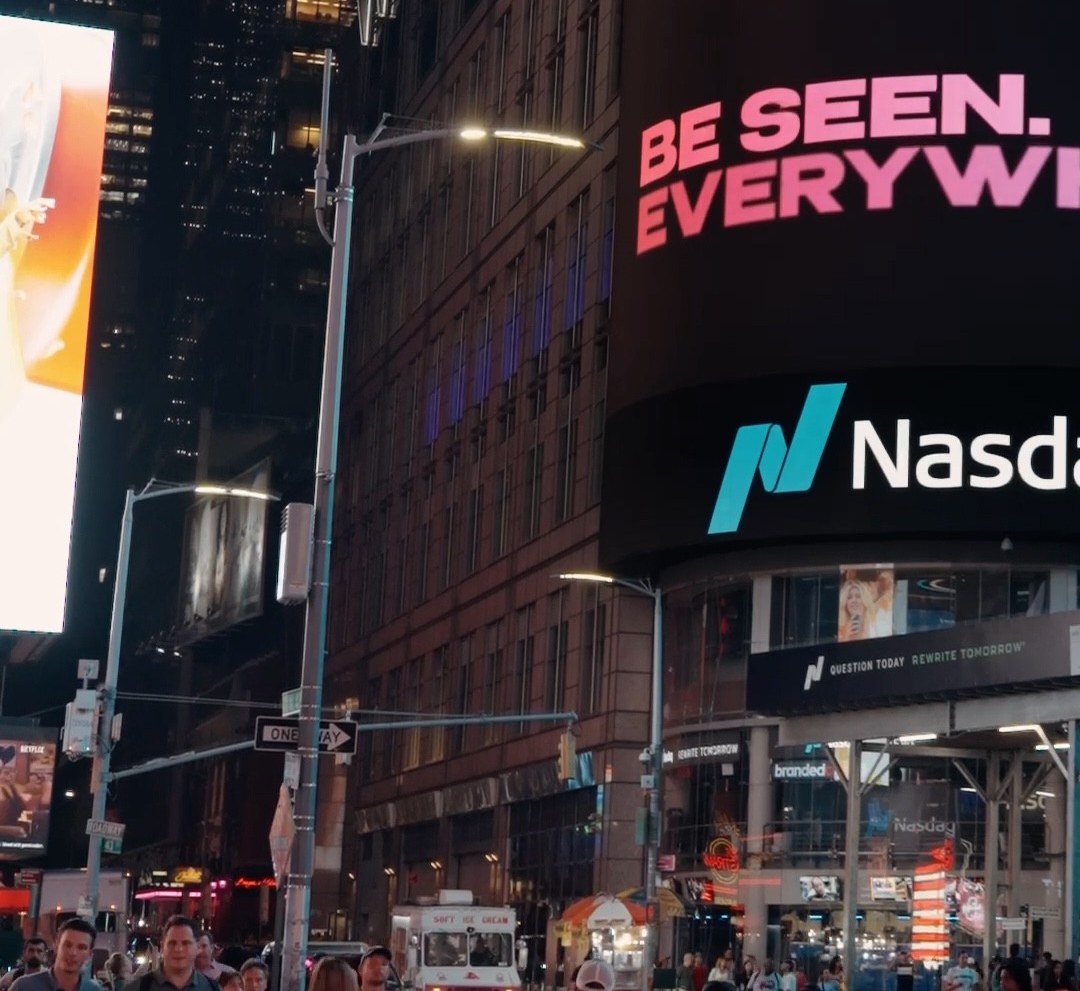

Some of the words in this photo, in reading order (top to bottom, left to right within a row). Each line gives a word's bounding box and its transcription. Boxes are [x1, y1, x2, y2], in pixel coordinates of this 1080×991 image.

[639, 101, 721, 188] BE
[739, 74, 1051, 153] SEEN.
[830, 660, 873, 676] QUESTION
[876, 656, 905, 669] TODAY
[912, 650, 957, 665] REWRITE
[961, 642, 1022, 659] TOMORROW
[271, 728, 299, 741] ONE
[20, 745, 45, 753] NETFLIX
[700, 744, 738, 757] TOMORROW
[774, 763, 826, 778] branded
[433, 916, 455, 924] SOFT
[463, 916, 475, 924] ICE
[482, 916, 509, 924] CREAM
